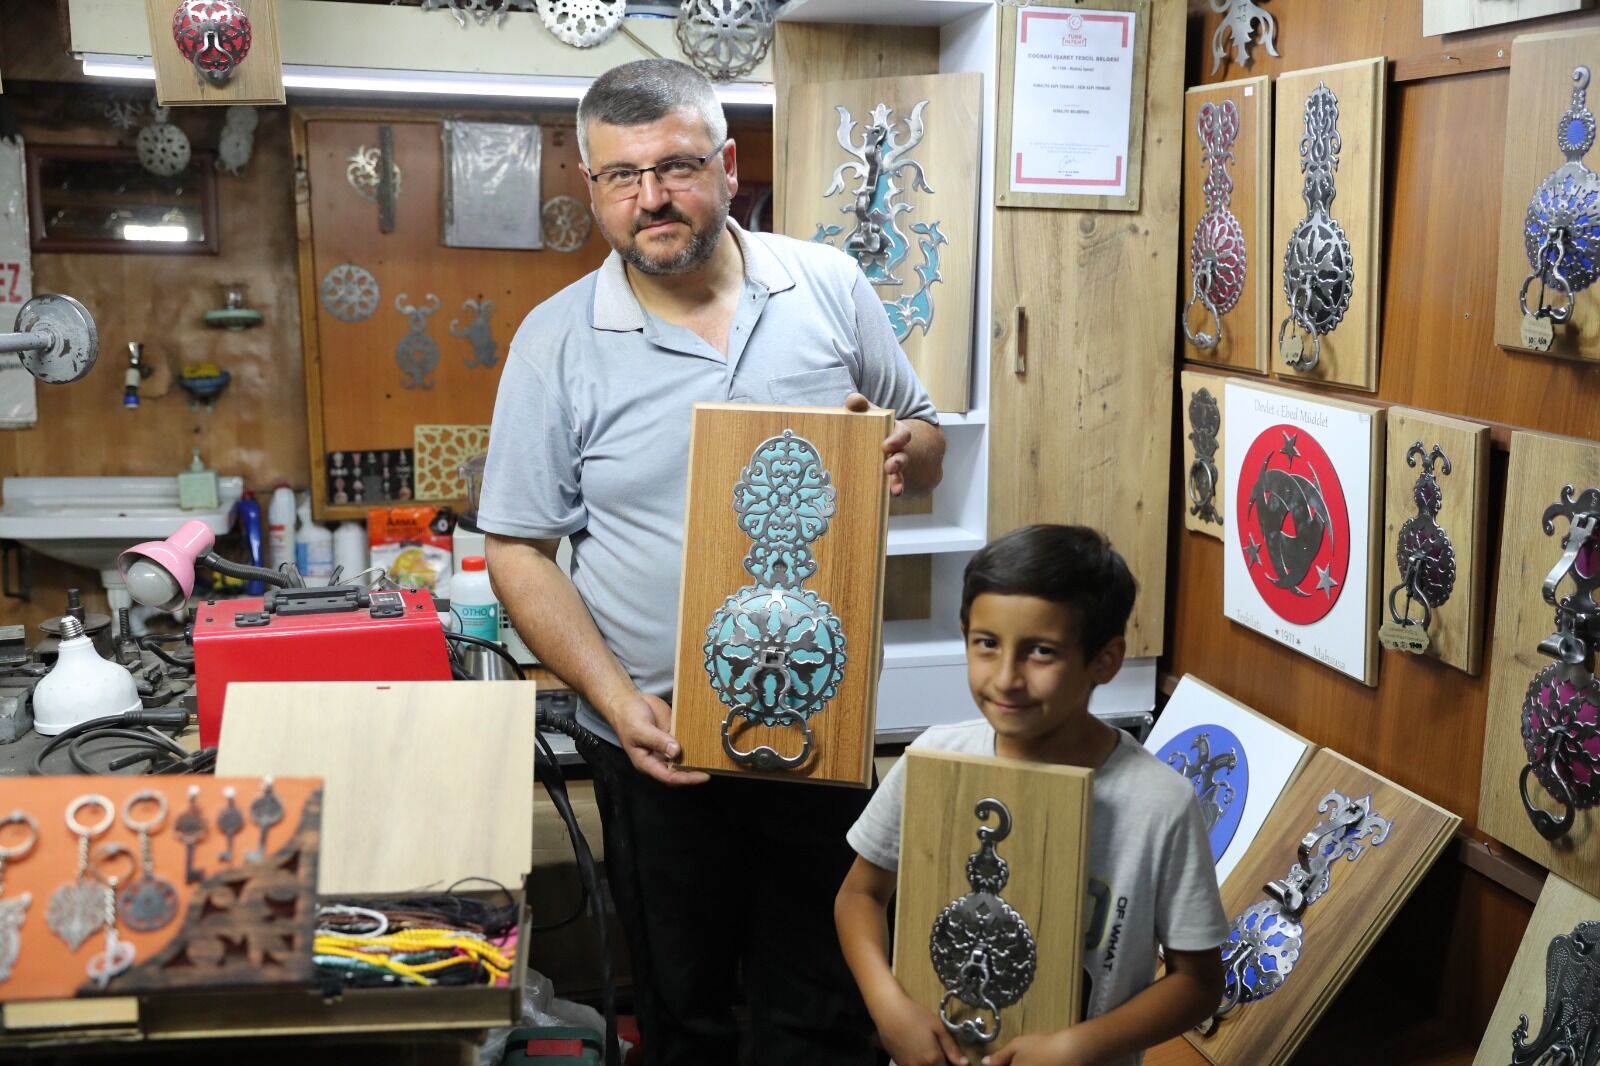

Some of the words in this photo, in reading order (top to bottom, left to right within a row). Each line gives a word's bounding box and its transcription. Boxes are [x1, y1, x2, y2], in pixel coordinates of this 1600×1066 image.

[1281, 628, 1295, 645] 1911
[1116, 896, 1128, 919] OF
[1102, 924, 1122, 972] WHAT
